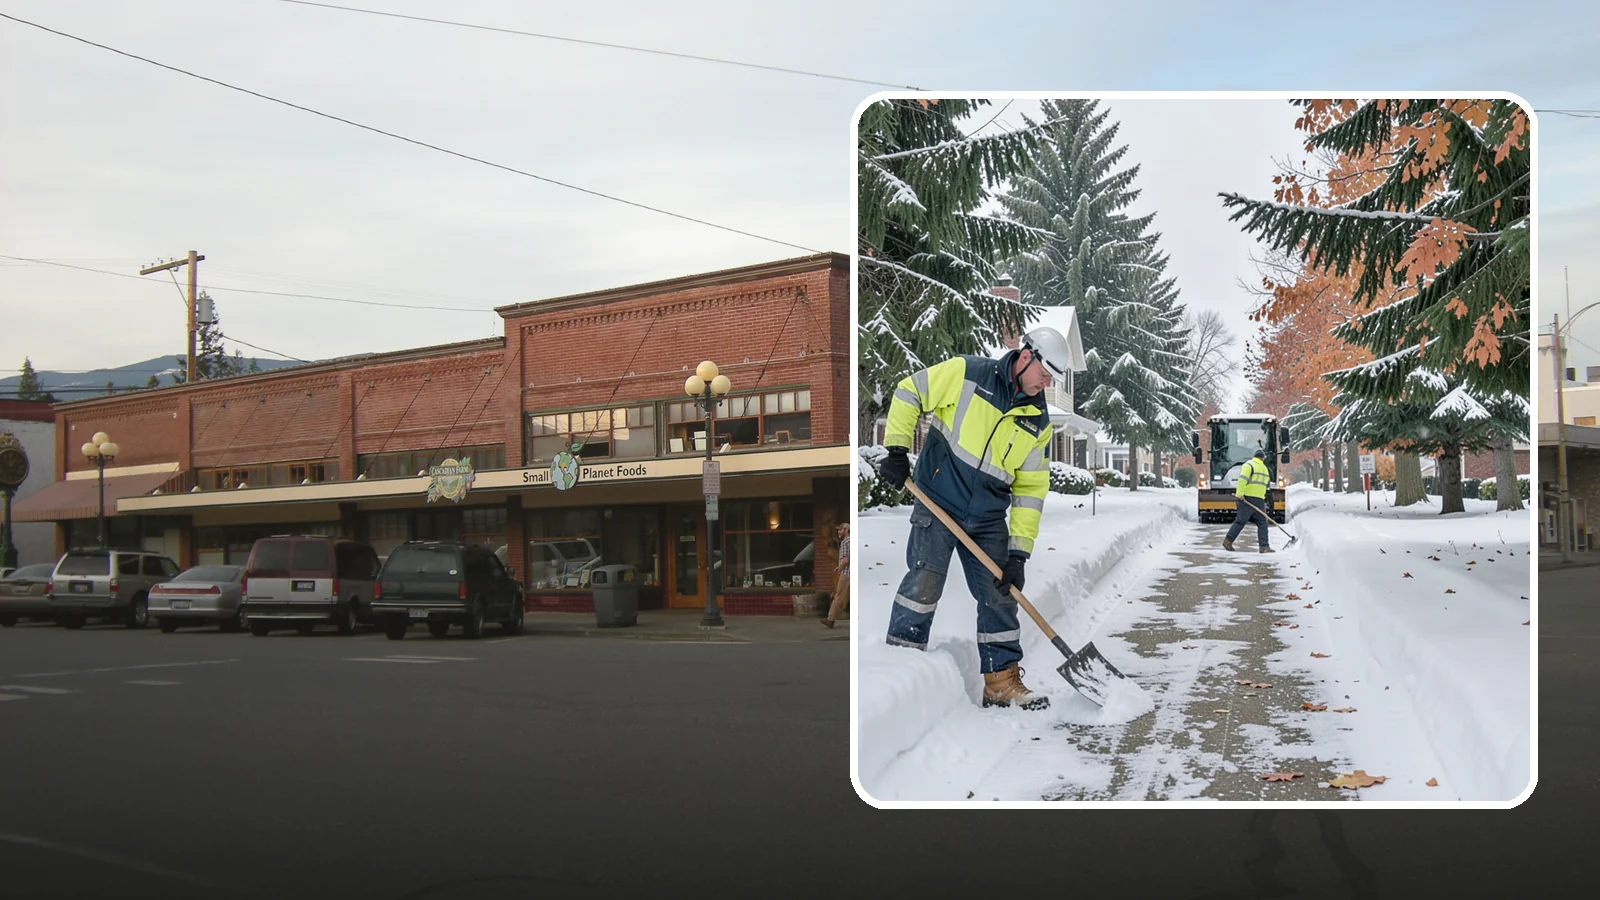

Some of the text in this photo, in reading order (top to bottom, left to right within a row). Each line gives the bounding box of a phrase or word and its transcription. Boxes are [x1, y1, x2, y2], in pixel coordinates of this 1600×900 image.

[523, 464, 647, 482] Small Planet Foods
